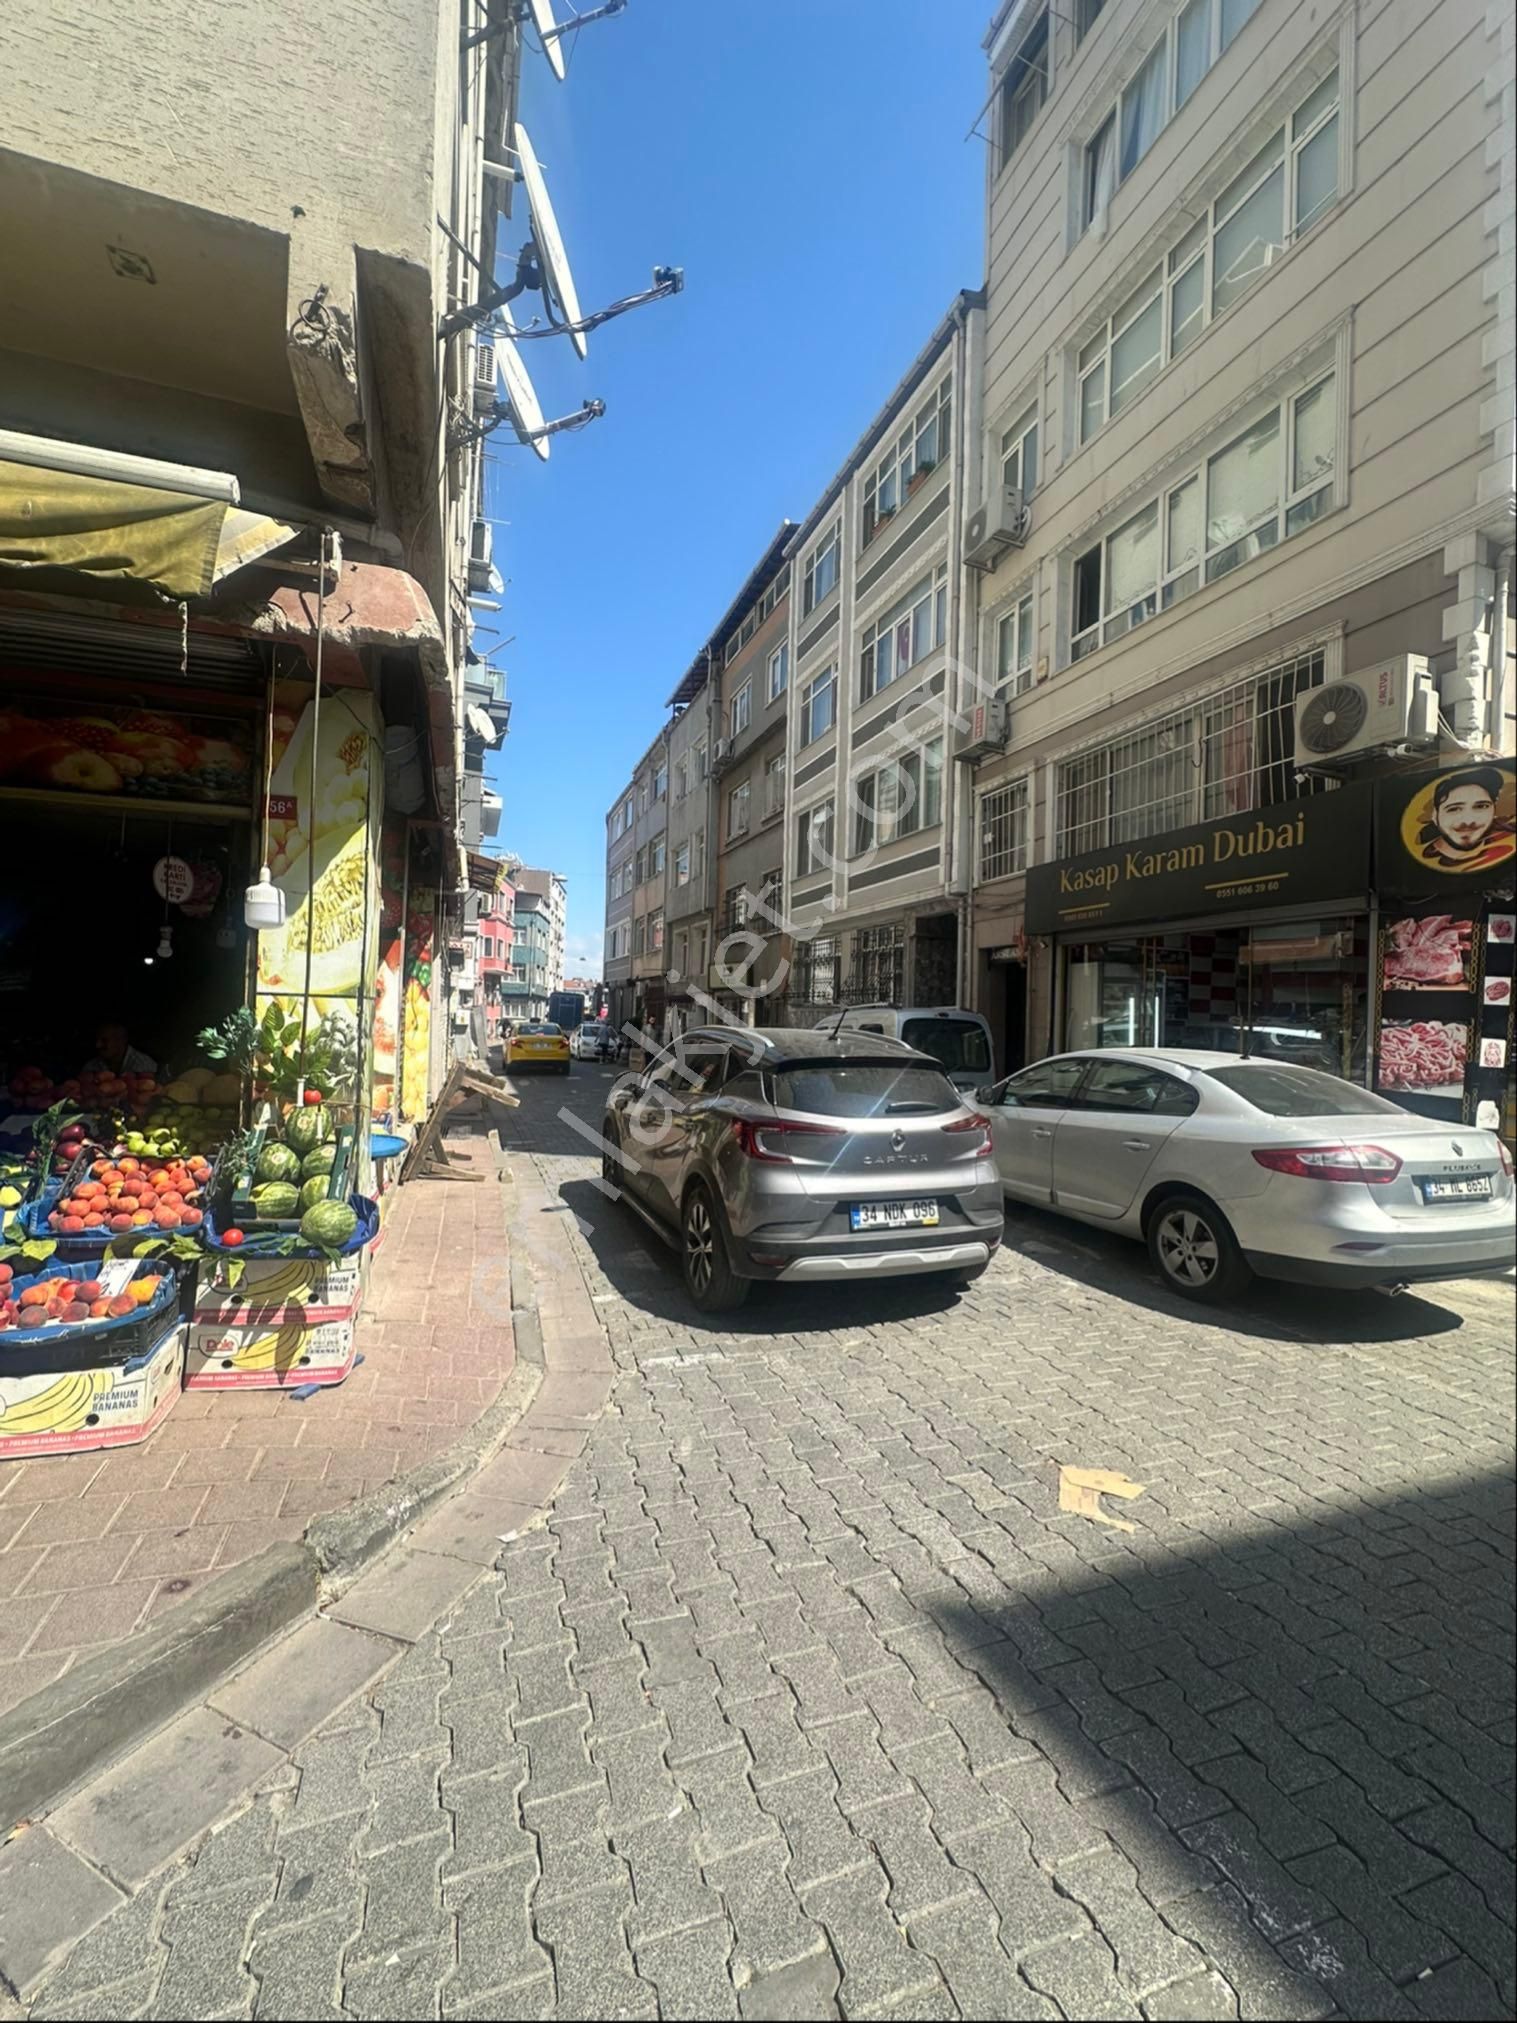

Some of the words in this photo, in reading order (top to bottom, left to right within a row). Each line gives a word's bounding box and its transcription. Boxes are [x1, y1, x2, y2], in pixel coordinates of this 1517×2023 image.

[1060, 863, 1119, 893] Kasap
[1126, 844, 1204, 880] Karam
[1213, 812, 1305, 862] Dubai
[863, 1153, 929, 1165] CAPTUR
[862, 1206, 878, 1222] 34
[883, 1203, 908, 1221] NDK
[912, 1201, 937, 1219] 096
[93, 1389, 139, 1401] PREMIUM
[92, 1399, 138, 1411] BANANAS
